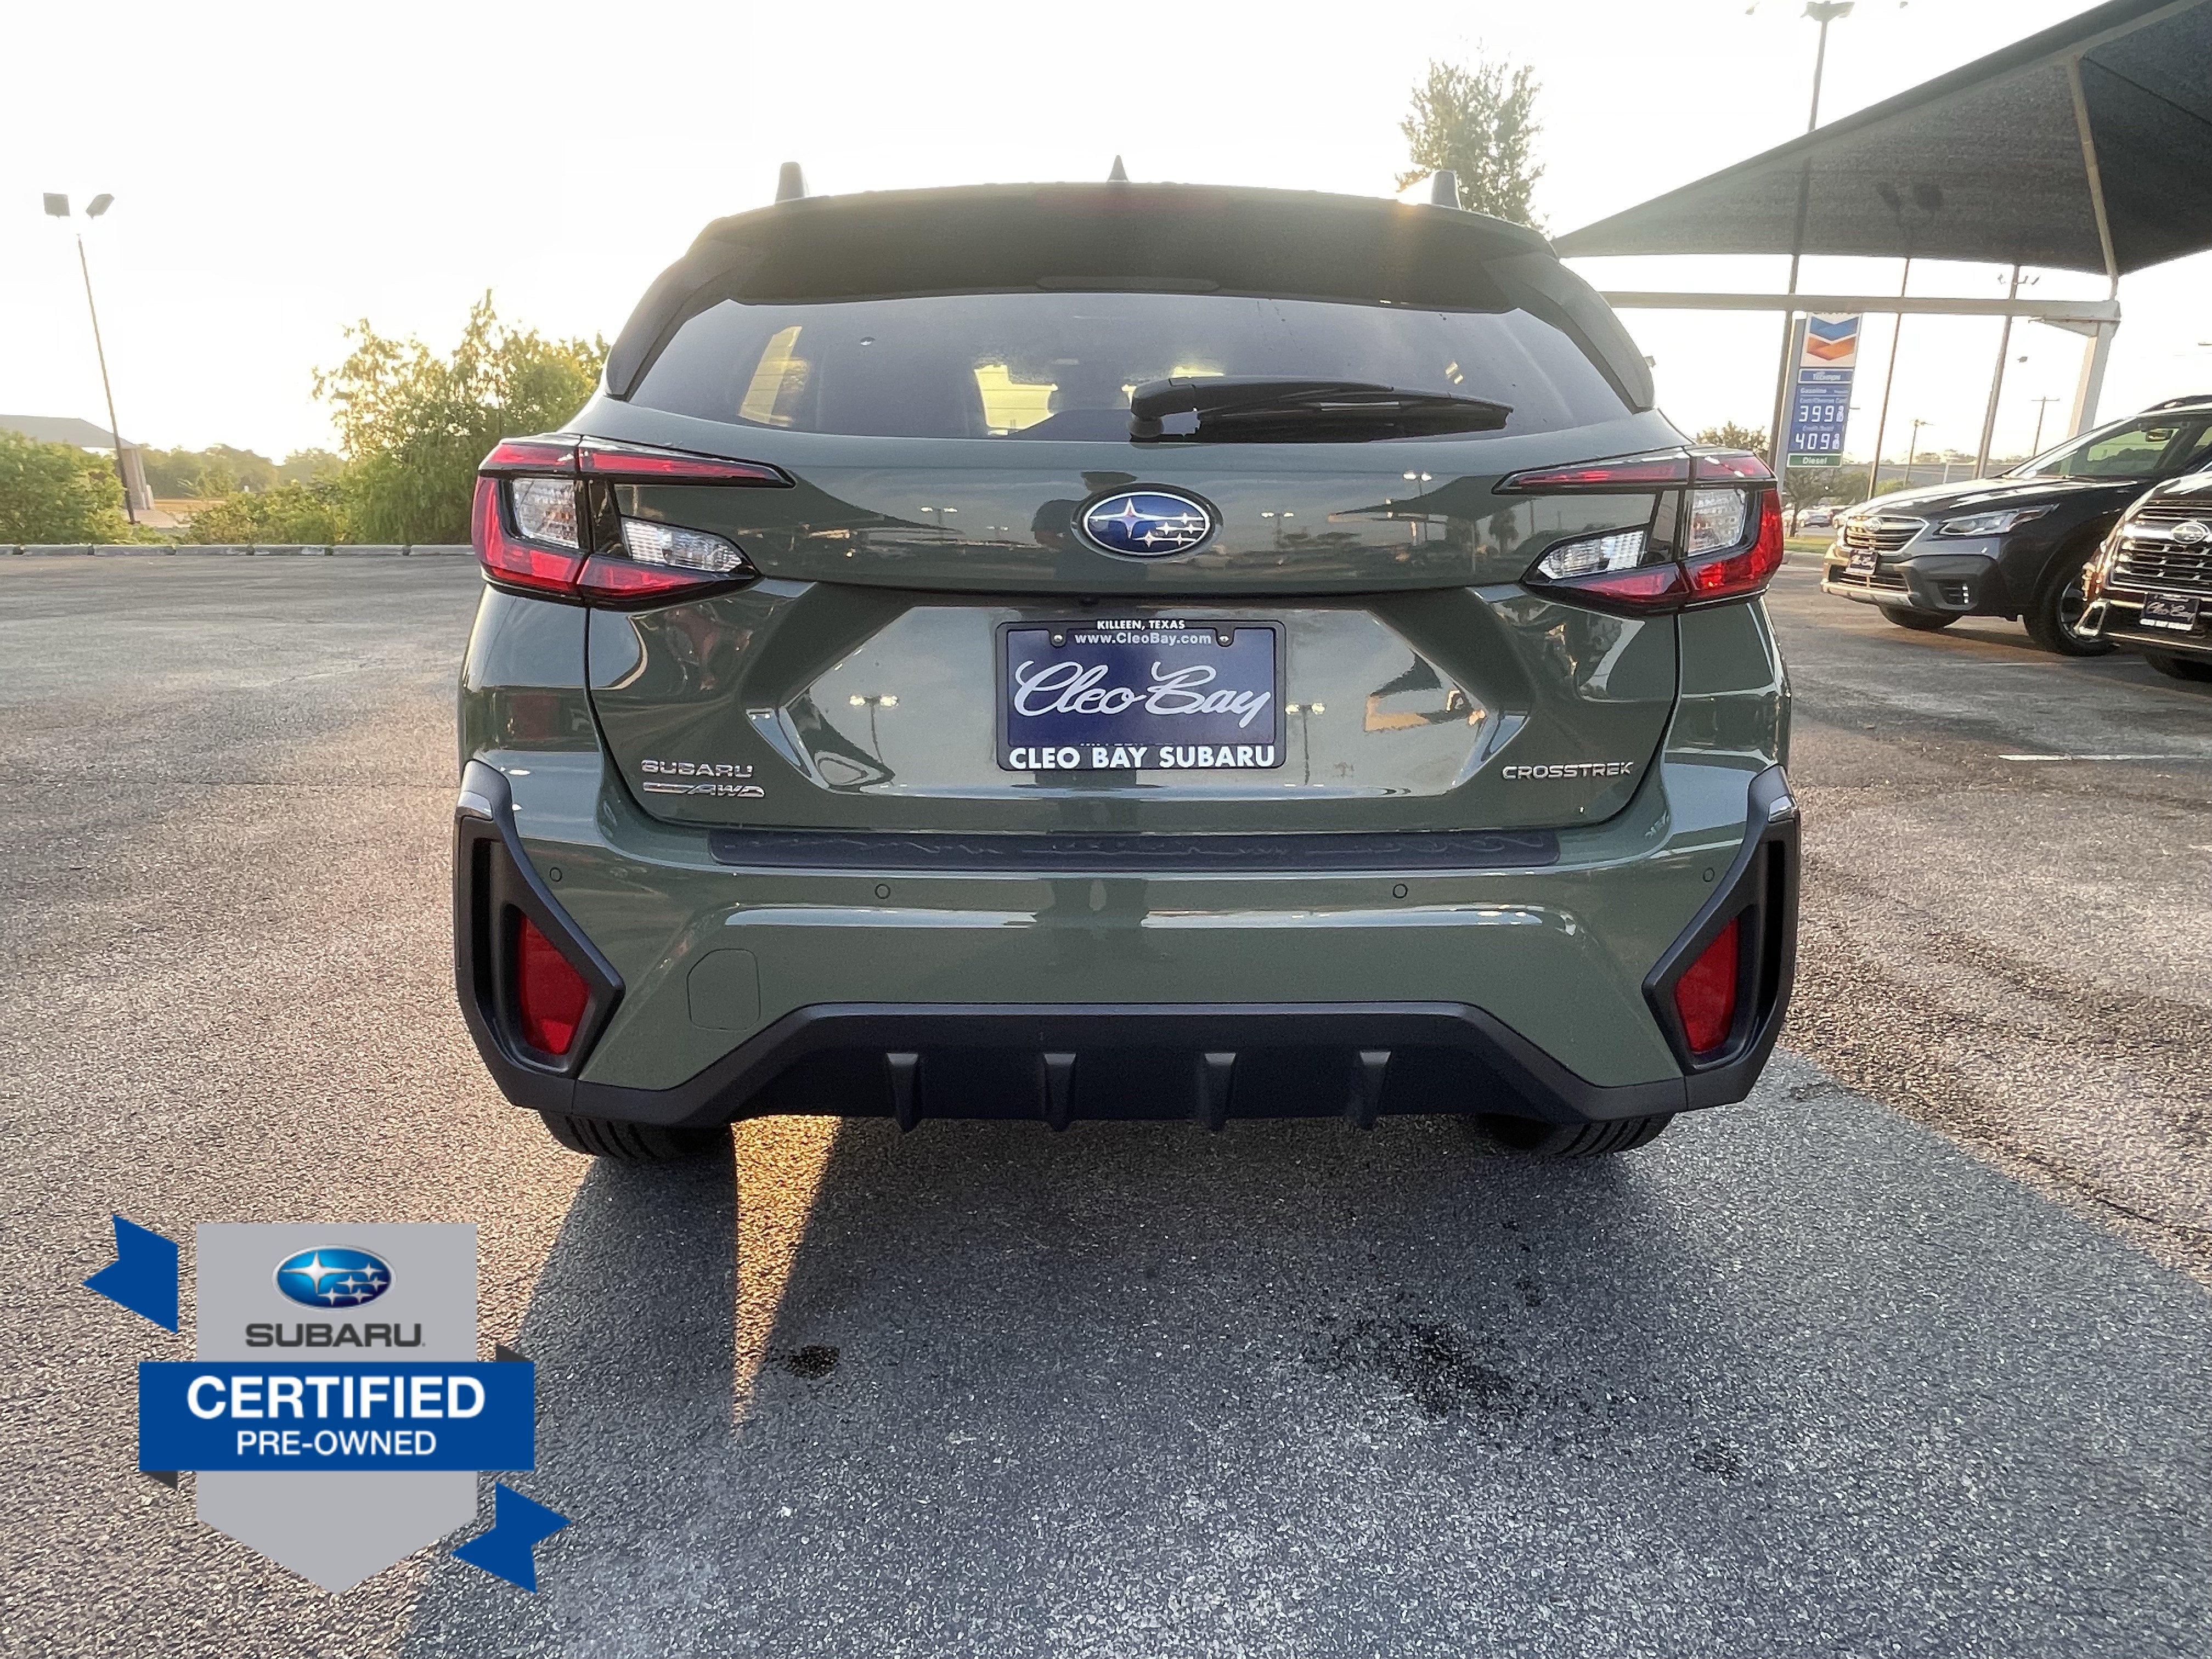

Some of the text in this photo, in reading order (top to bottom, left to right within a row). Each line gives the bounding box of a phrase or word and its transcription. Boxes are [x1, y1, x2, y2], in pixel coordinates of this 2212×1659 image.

[1803, 456, 1828, 465] Diesel
[1097, 620, 1186, 630] KILLEEN, TEXAS
[1074, 632, 1212, 646] www.CleoBay.com
[1014, 660, 1271, 729] Cleo Bay
[1009, 745, 1274, 769] CLEO BAY SUBARU
[641, 759, 753, 778] SUBARU
[1502, 761, 1634, 780] CROSSTREK
[687, 783, 766, 798] AWD
